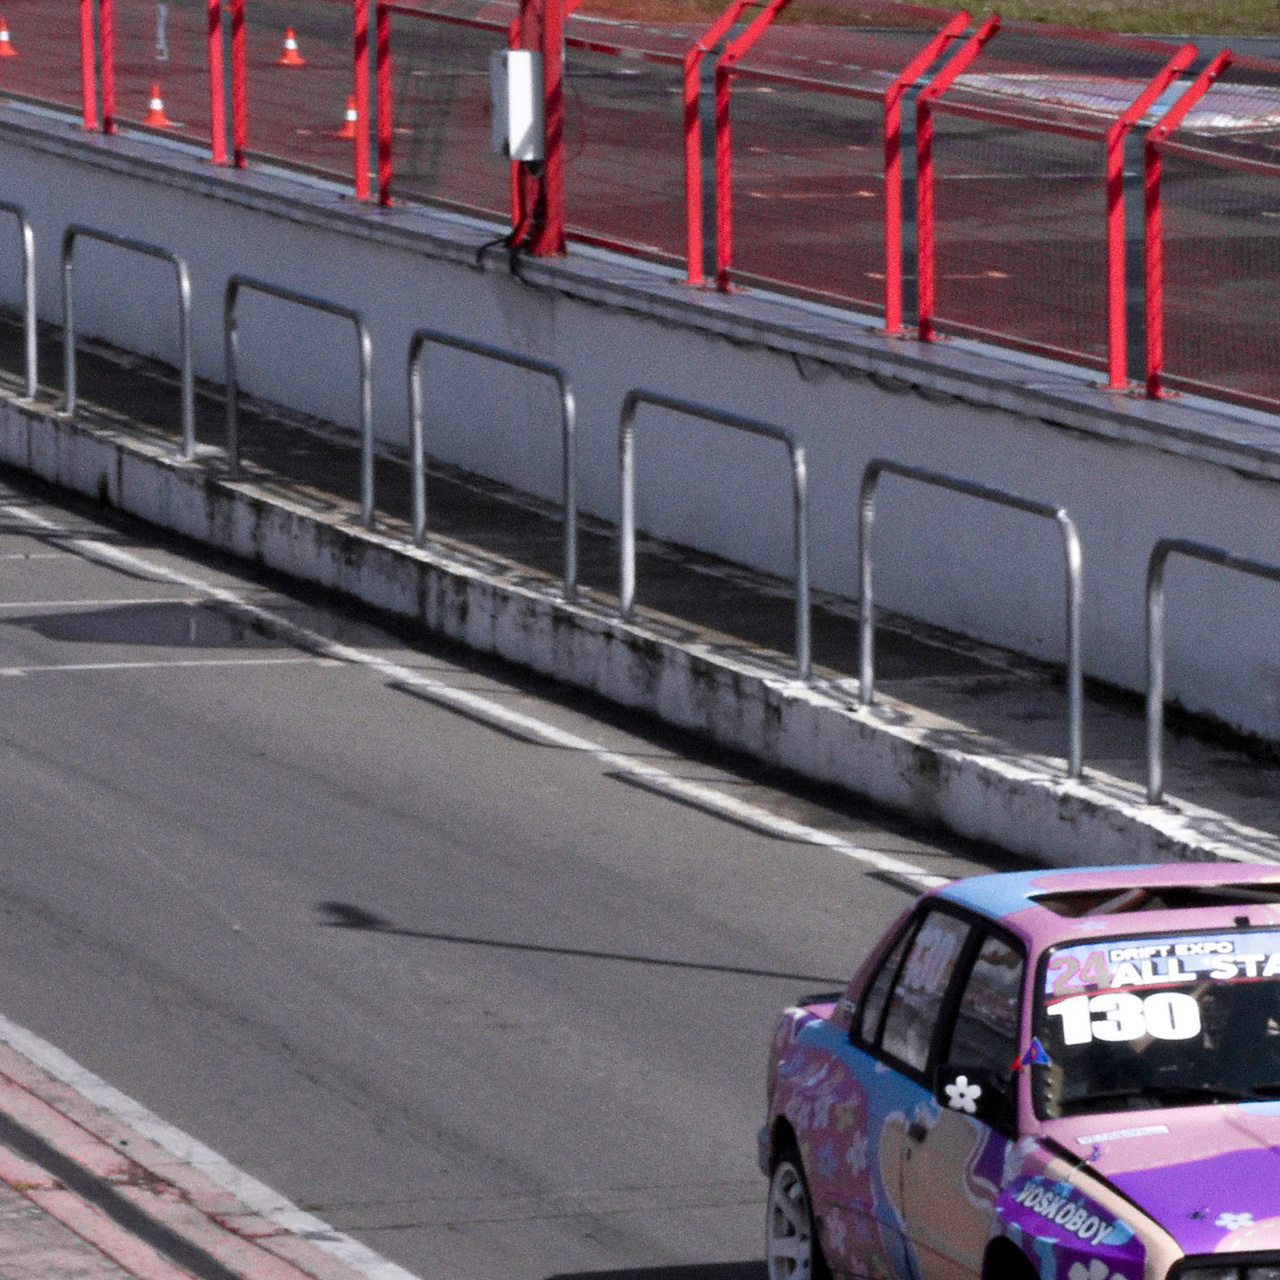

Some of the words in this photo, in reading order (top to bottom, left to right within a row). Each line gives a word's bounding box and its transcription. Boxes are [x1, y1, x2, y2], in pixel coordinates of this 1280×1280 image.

[1049, 951, 1114, 996] 24
[1109, 944, 1172, 962] DRIFT
[1174, 941, 1234, 956] EXPO
[1110, 958, 1197, 988] ALL
[1047, 992, 1201, 1046] 130
[1015, 1180, 1114, 1246] VOSKOBOY
